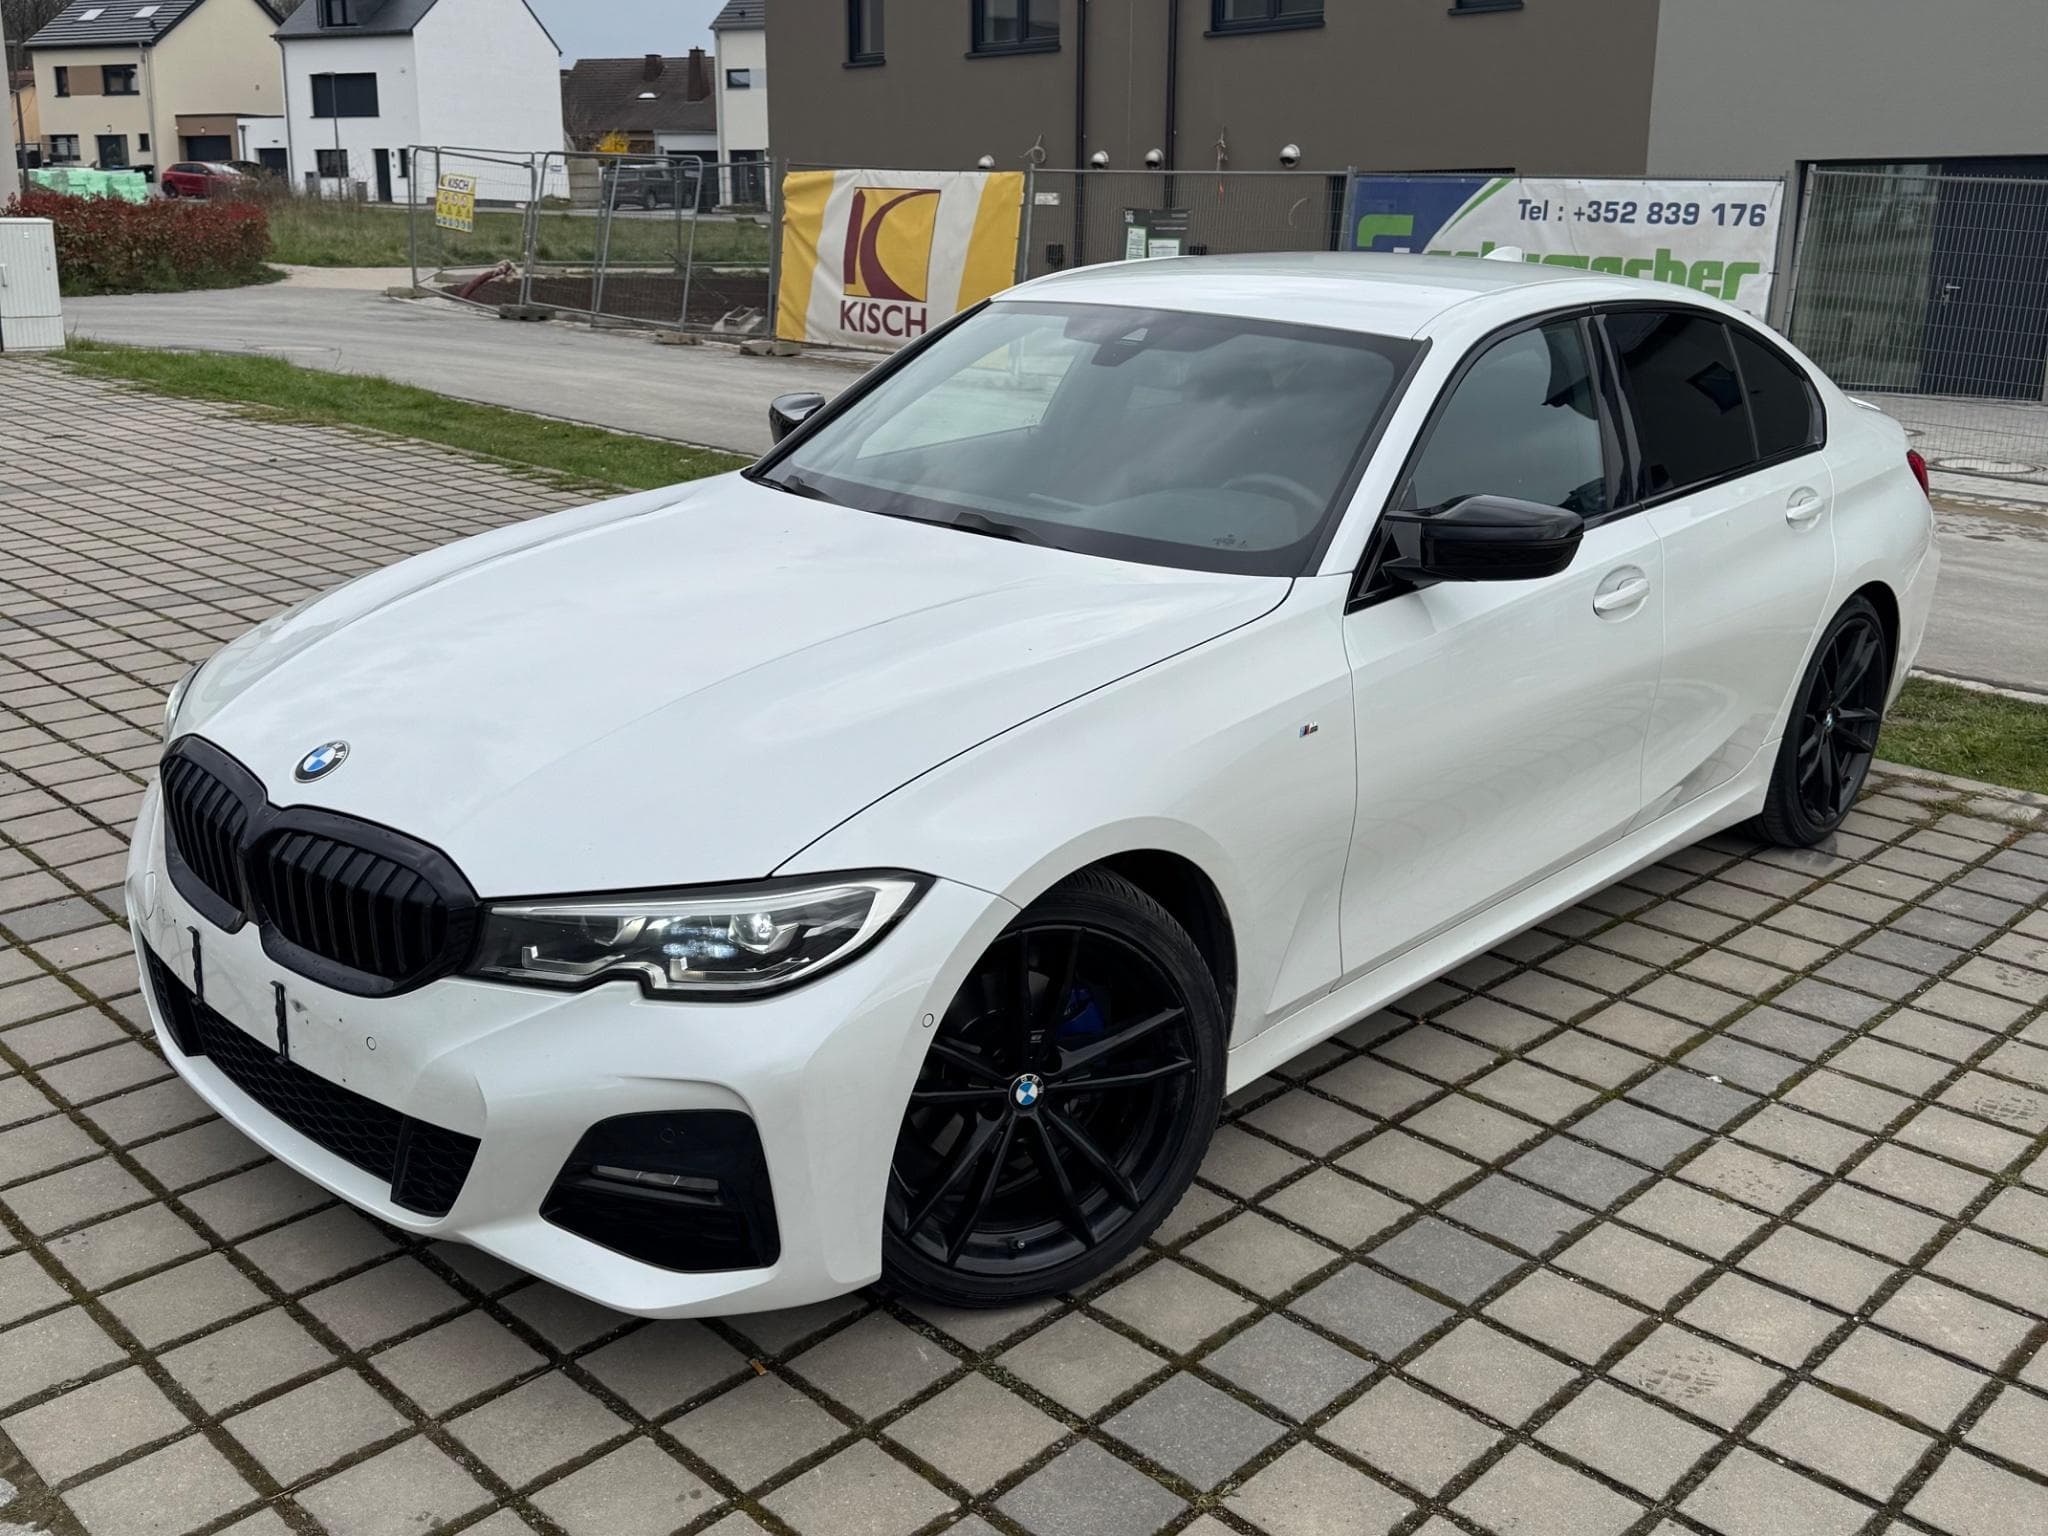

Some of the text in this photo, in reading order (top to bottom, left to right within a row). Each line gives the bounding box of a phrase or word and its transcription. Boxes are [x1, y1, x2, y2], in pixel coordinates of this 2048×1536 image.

[1518, 199, 1548, 221] Tel
[1574, 201, 1637, 223] +352
[1646, 202, 1700, 225] 839
[1711, 203, 1766, 226] 176
[840, 300, 927, 337] KISCH
